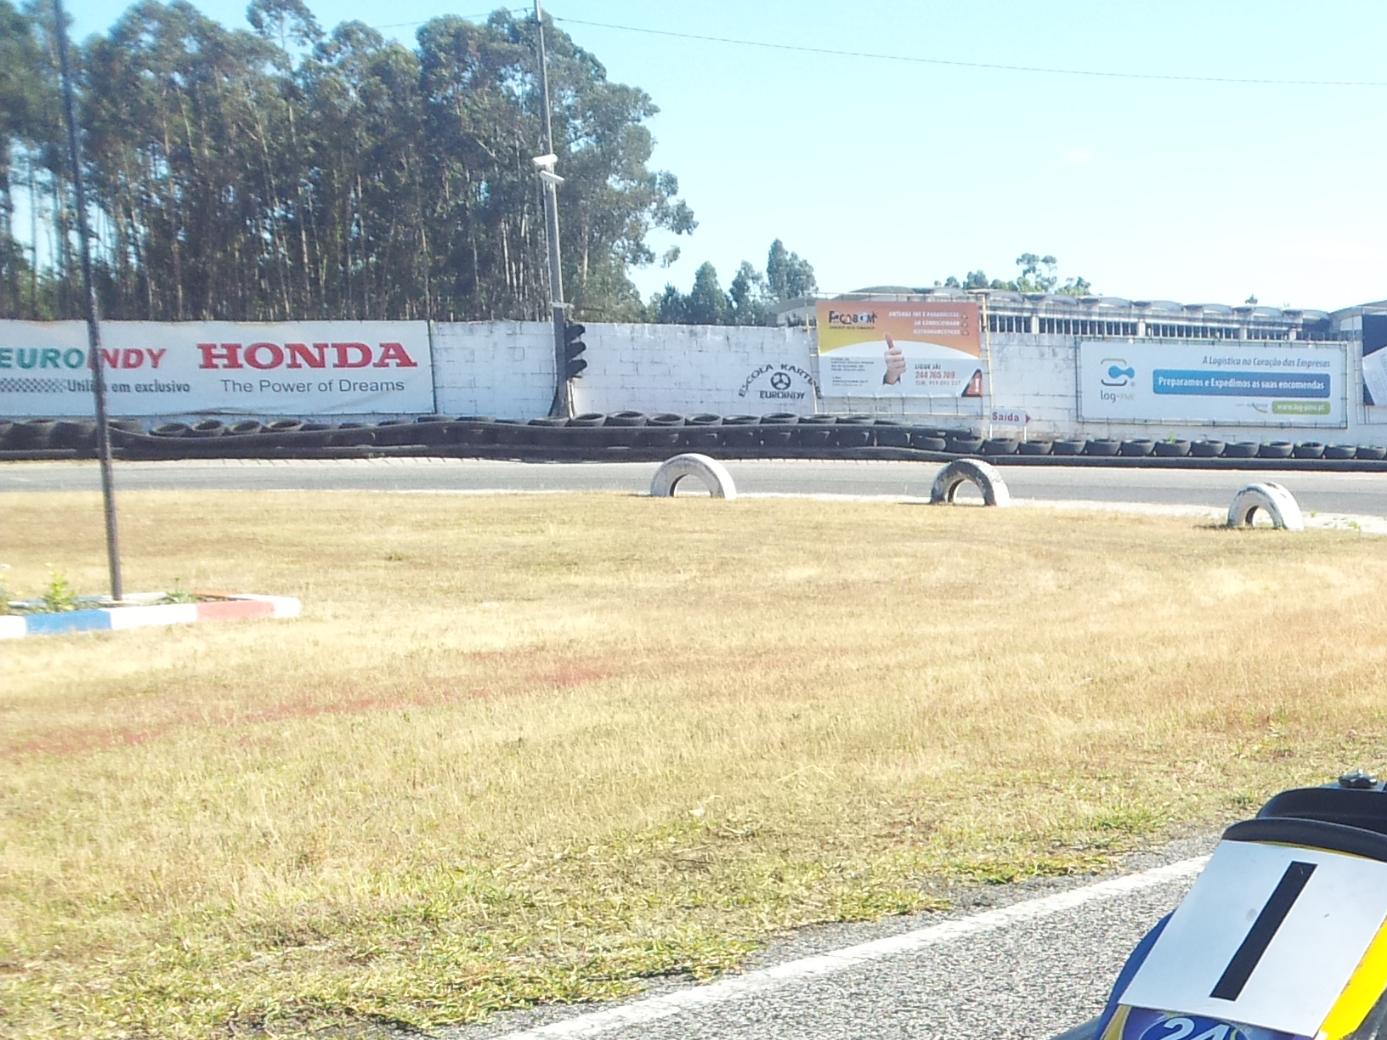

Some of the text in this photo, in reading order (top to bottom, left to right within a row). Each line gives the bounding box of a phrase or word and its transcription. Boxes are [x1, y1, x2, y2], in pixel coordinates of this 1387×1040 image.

[197, 342, 418, 369] HONDA
[111, 383, 131, 393] em
[135, 379, 190, 393] exclusivo
[221, 378, 405, 393] The Power of Dreams
[1158, 376, 1203, 389] Preparamos
[1211, 377, 1251, 389] Expedimos
[1278, 380, 1325, 390] encomendas
[1209, 860, 1319, 1002] 1
